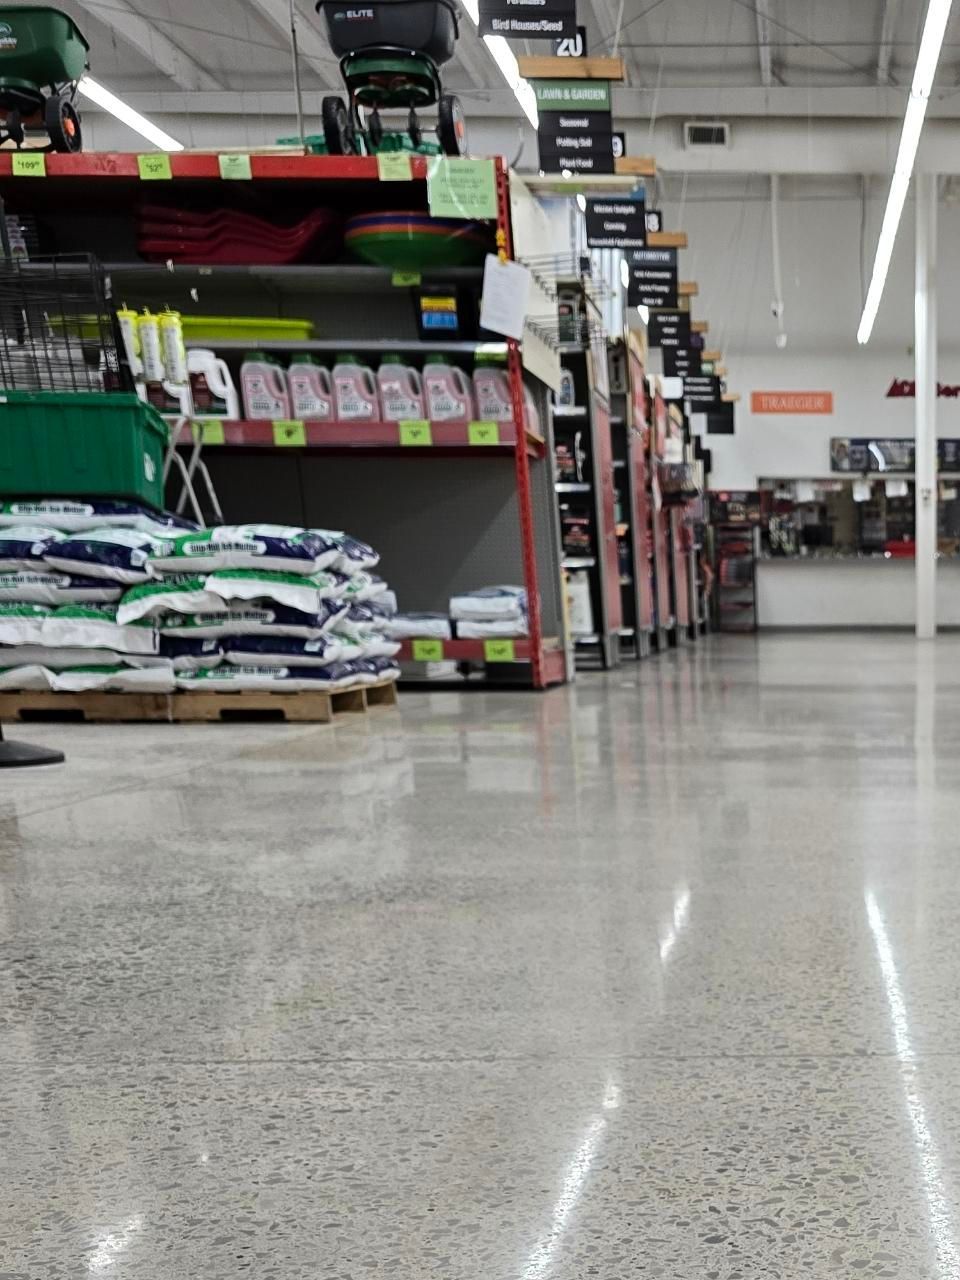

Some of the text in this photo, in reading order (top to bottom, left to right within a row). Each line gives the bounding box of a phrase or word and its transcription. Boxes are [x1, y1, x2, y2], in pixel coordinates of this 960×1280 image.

[347, 9, 373, 18] ELITE
[492, 18, 563, 31] Bird Houses/Seed
[556, 33, 583, 57] 20
[537, 88, 606, 101] LAWN & GARDEN
[612, 135, 623, 158] 9
[761, 395, 825, 410] TRAEGER
